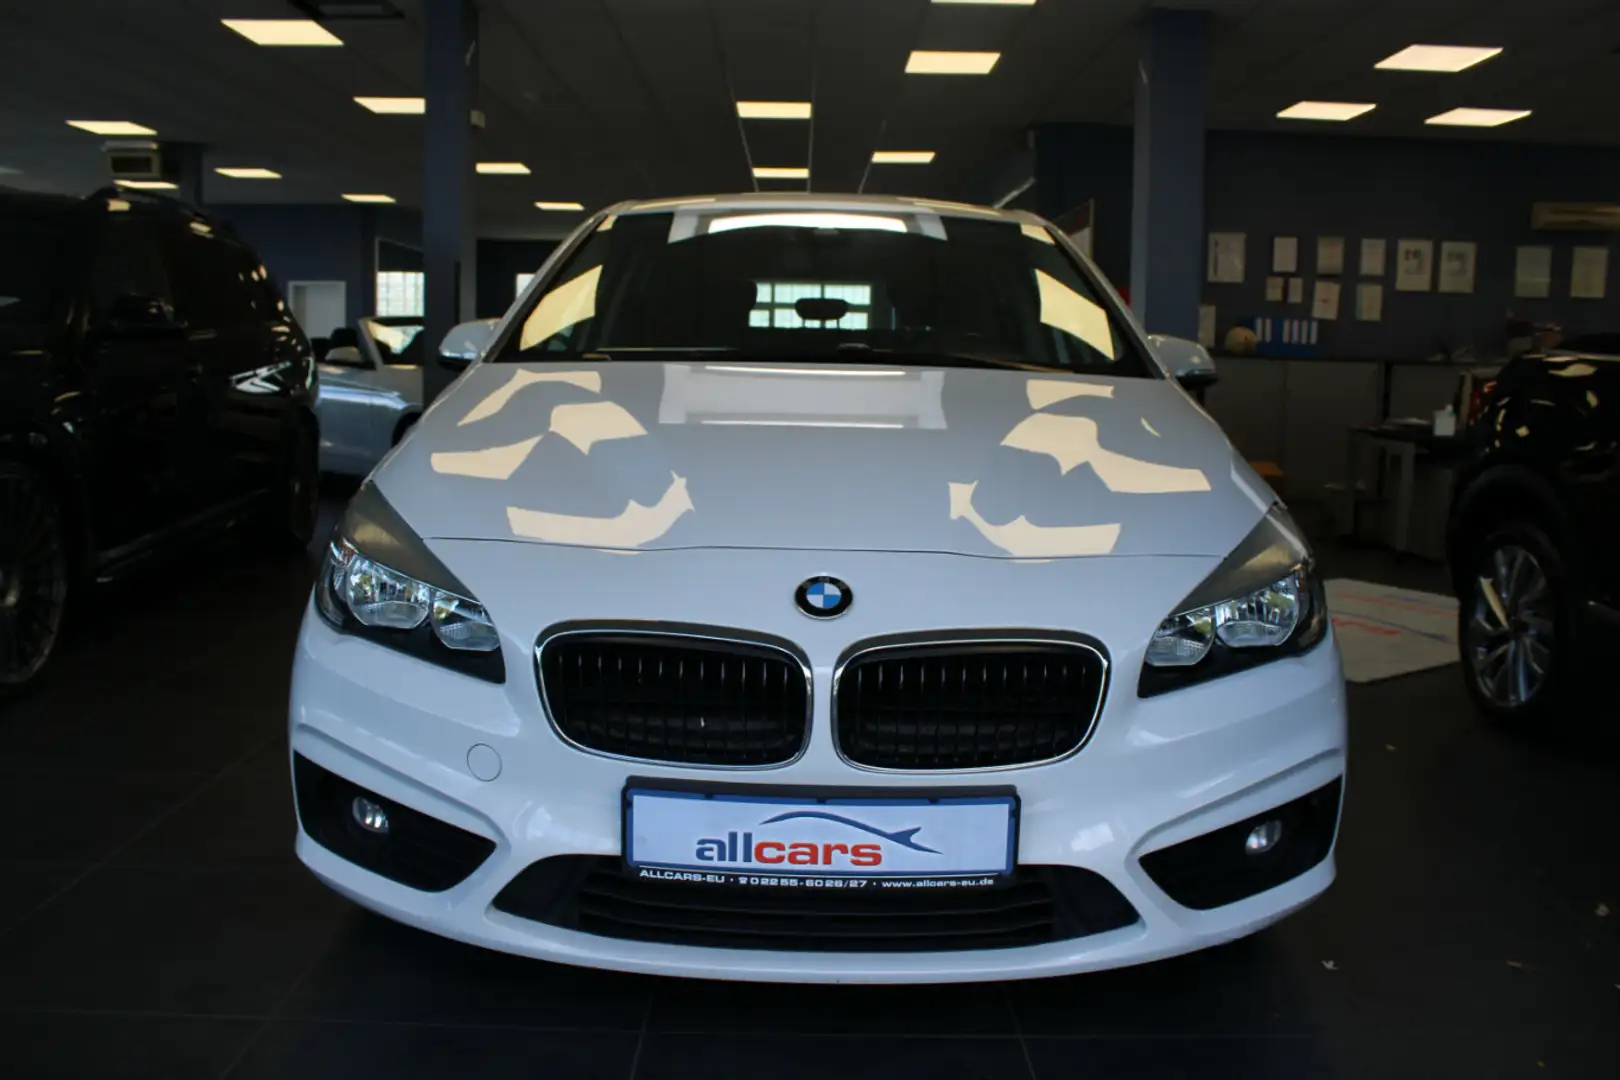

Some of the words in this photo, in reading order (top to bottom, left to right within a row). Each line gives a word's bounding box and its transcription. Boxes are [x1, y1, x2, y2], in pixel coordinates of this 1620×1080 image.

[695, 831, 883, 867] allcars
[639, 869, 725, 884] ALLCARS-EU
[881, 877, 995, 888] www.allcars-eu.de
